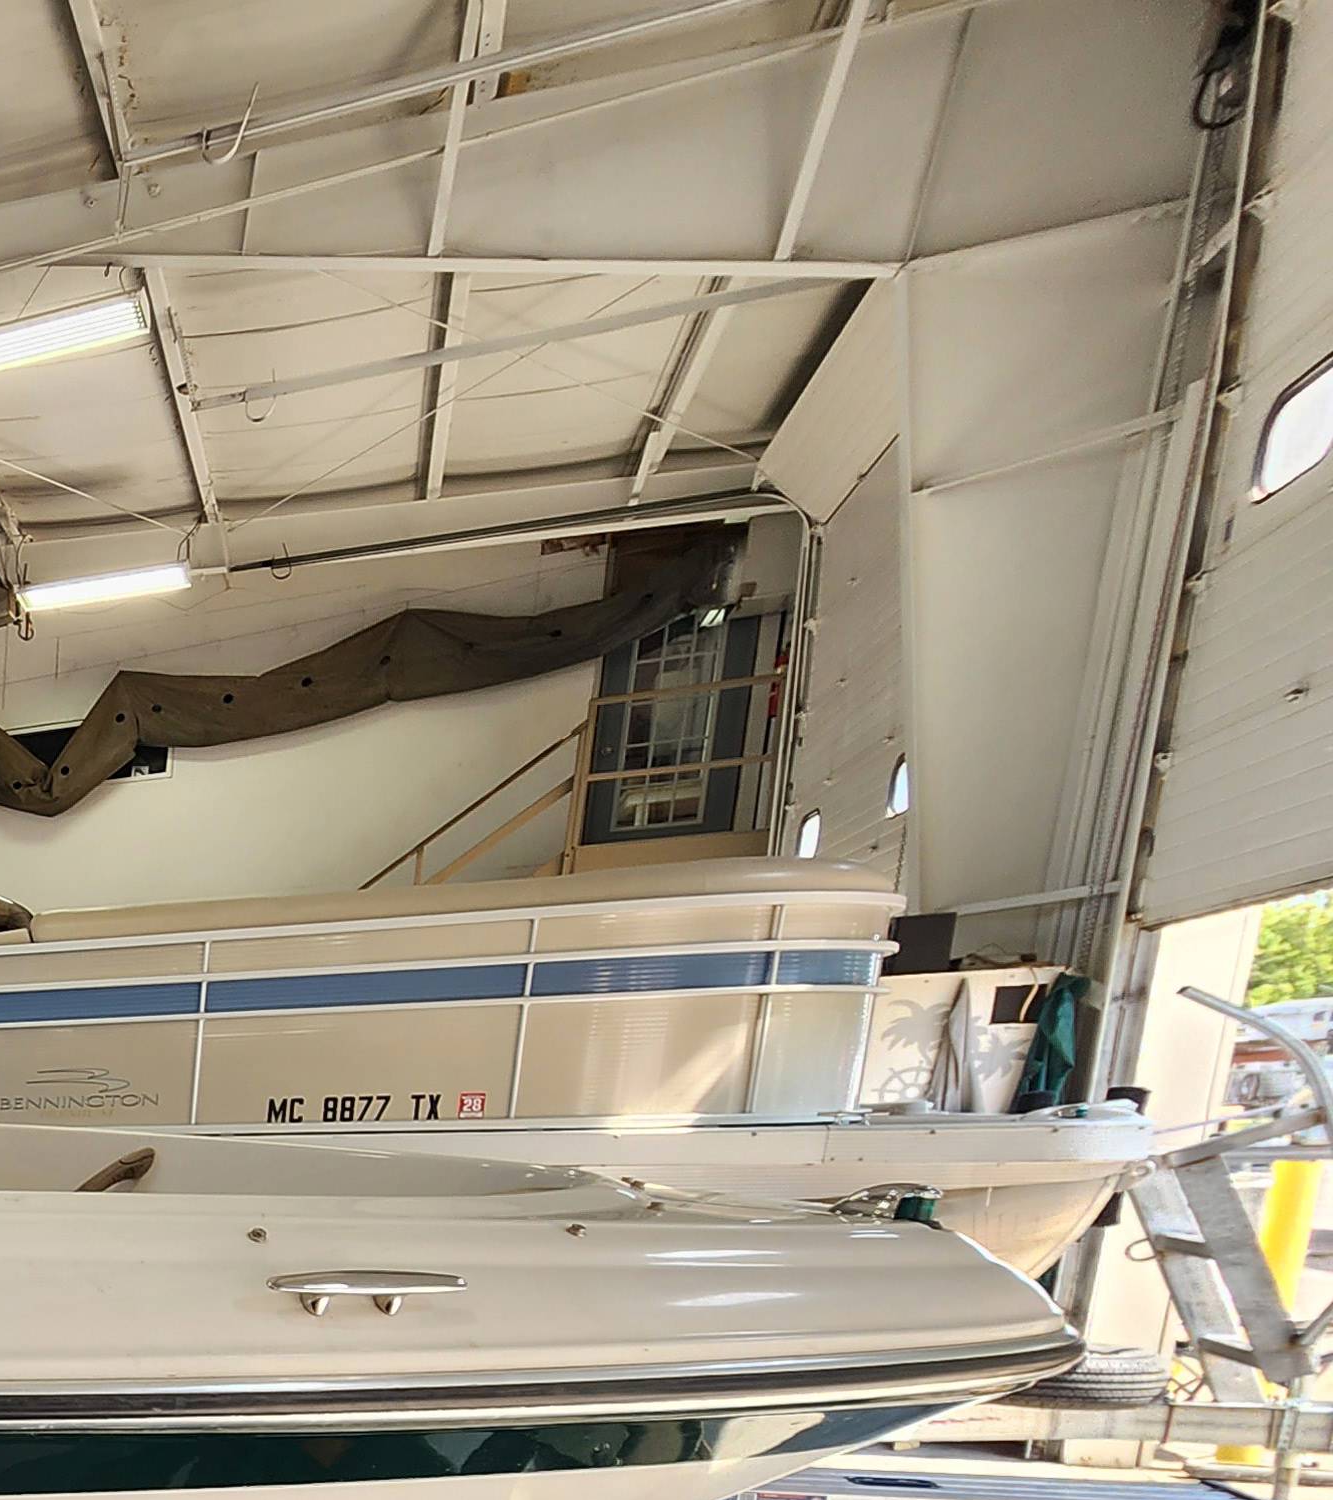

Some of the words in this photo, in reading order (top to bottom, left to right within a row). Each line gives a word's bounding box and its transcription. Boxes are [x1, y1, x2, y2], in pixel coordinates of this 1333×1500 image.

[0, 1093, 159, 1111] BENNINGTON
[266, 1098, 305, 1123] MC
[322, 1095, 391, 1122] 8877
[410, 1094, 441, 1121] TX
[463, 1098, 482, 1111] 28
